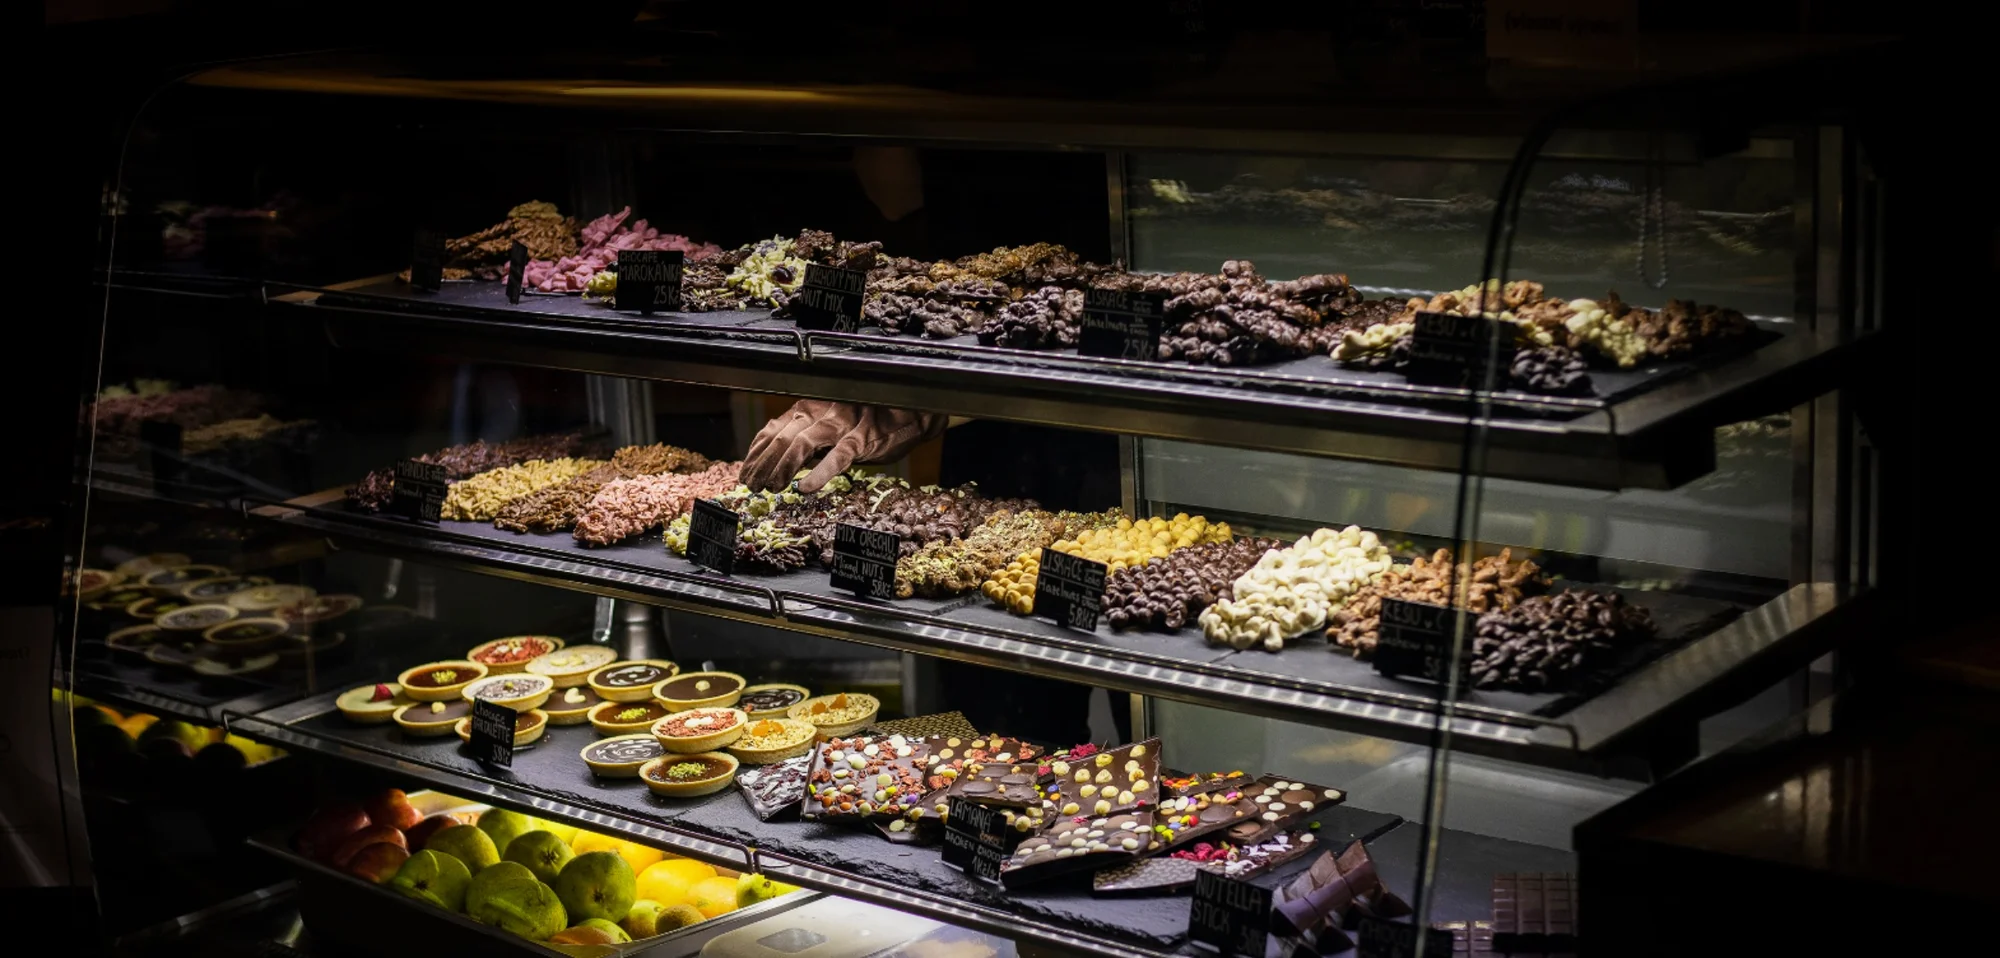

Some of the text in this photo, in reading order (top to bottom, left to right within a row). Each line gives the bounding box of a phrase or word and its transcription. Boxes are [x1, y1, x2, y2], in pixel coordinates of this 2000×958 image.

[801, 288, 844, 312] NUT MIX
[836, 524, 856, 544] MIX
[1195, 871, 1262, 915] NUTELLA
[1191, 899, 1230, 935] STICK
